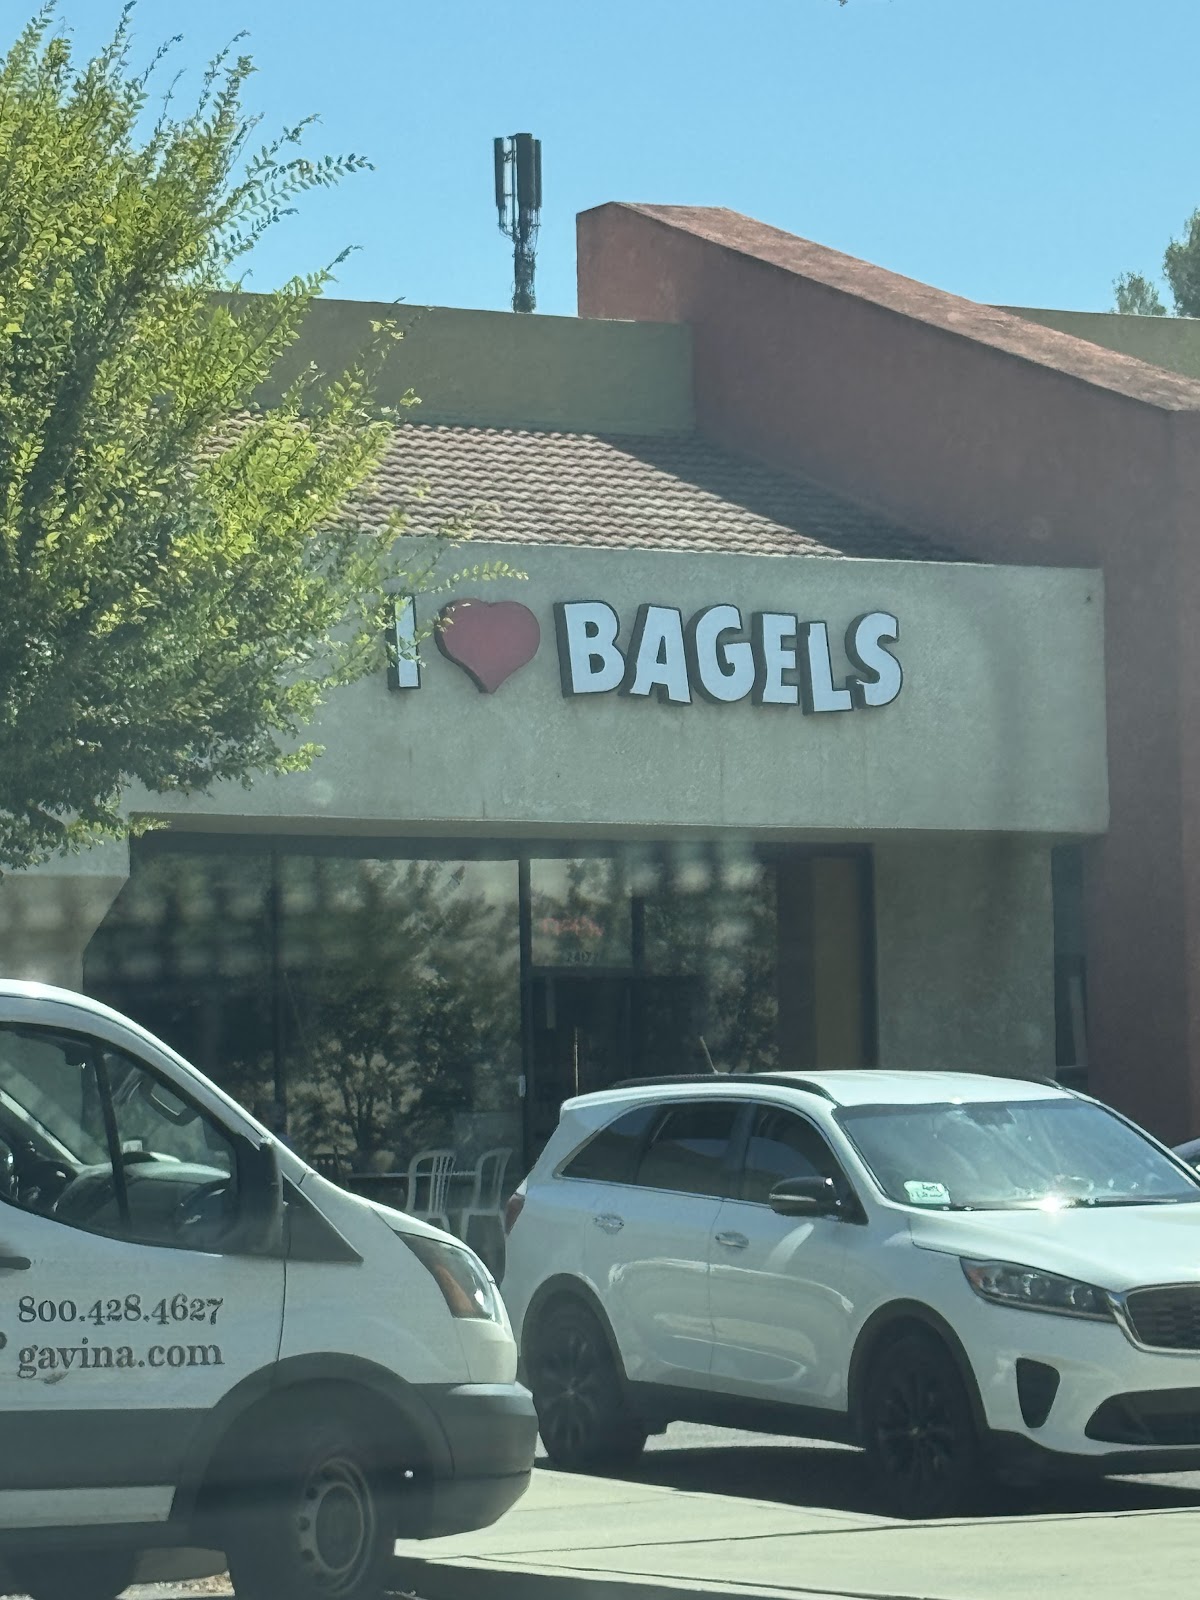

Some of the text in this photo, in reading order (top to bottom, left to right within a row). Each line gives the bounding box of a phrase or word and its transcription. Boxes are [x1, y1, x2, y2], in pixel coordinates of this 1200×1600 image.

[386, 594, 903, 713] I BAGELS
[18, 1293, 223, 1325] 800.428.4627
[17, 1337, 225, 1378] gavina.com
